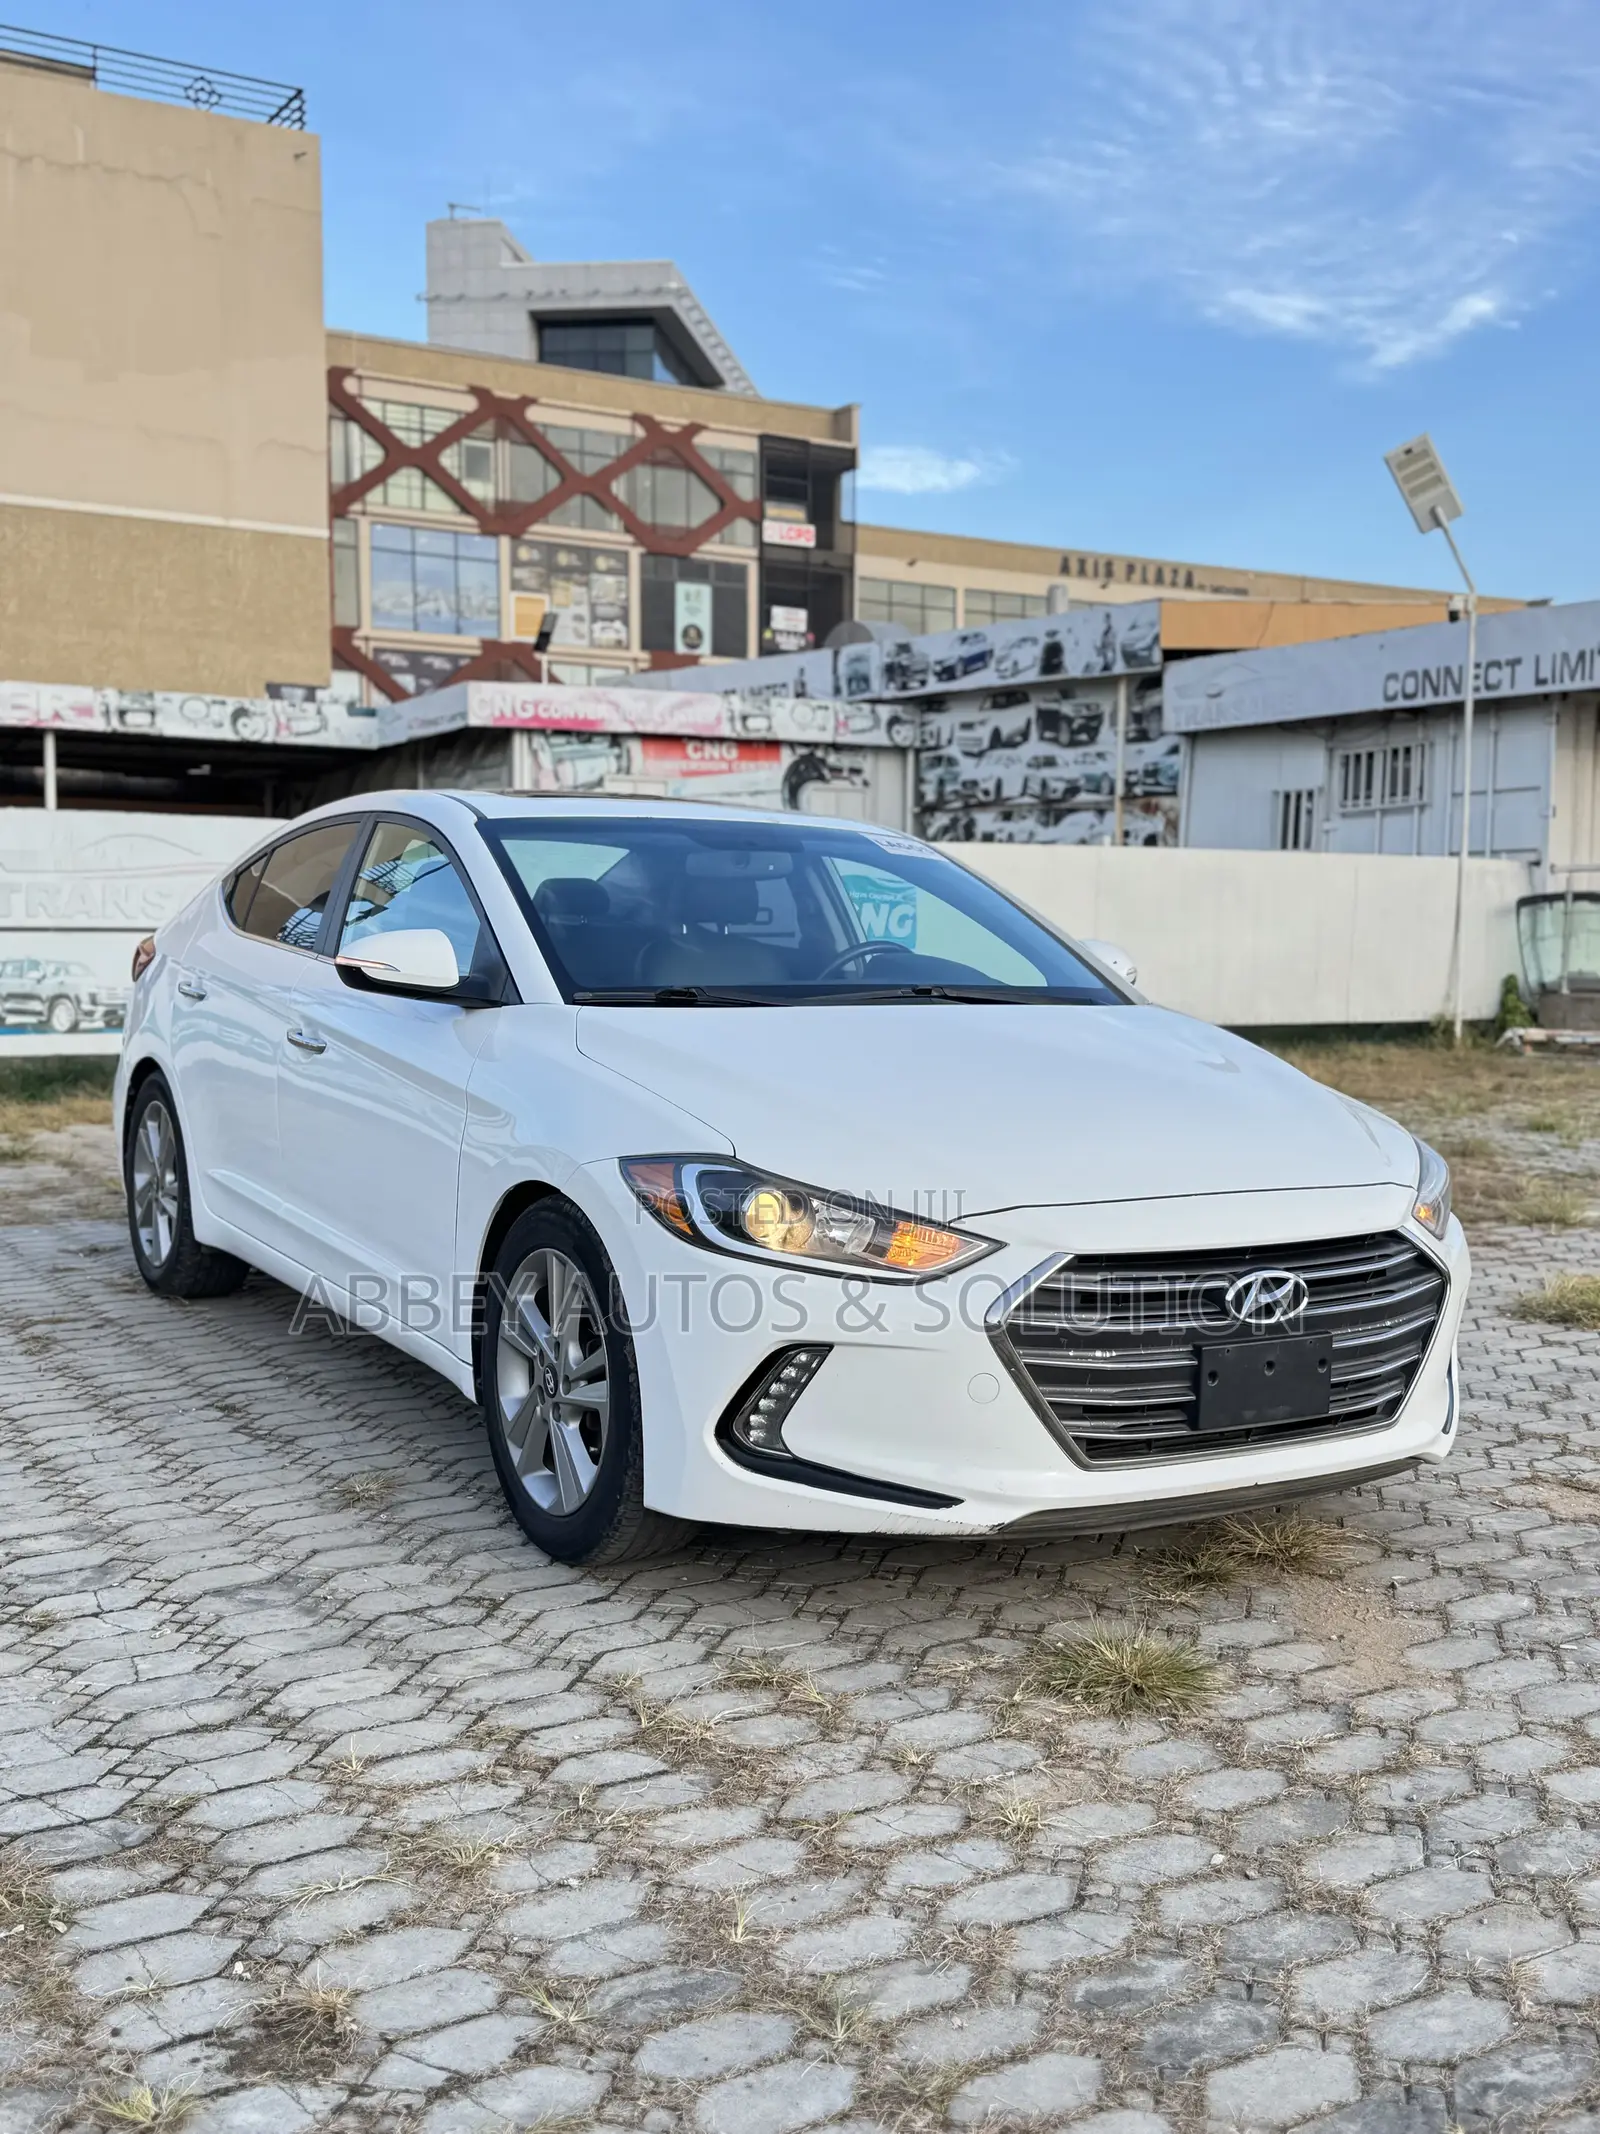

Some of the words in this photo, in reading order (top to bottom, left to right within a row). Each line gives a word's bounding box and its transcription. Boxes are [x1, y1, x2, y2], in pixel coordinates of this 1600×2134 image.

[1059, 555, 1114, 579] AXIS
[1125, 561, 1195, 589] PLAZA
[1383, 656, 1522, 703] CONNECT
[1534, 644, 1600, 687] LIMI
[471, 694, 533, 719] CNG
[685, 739, 739, 761] CNG
[853, 902, 916, 938] NG
